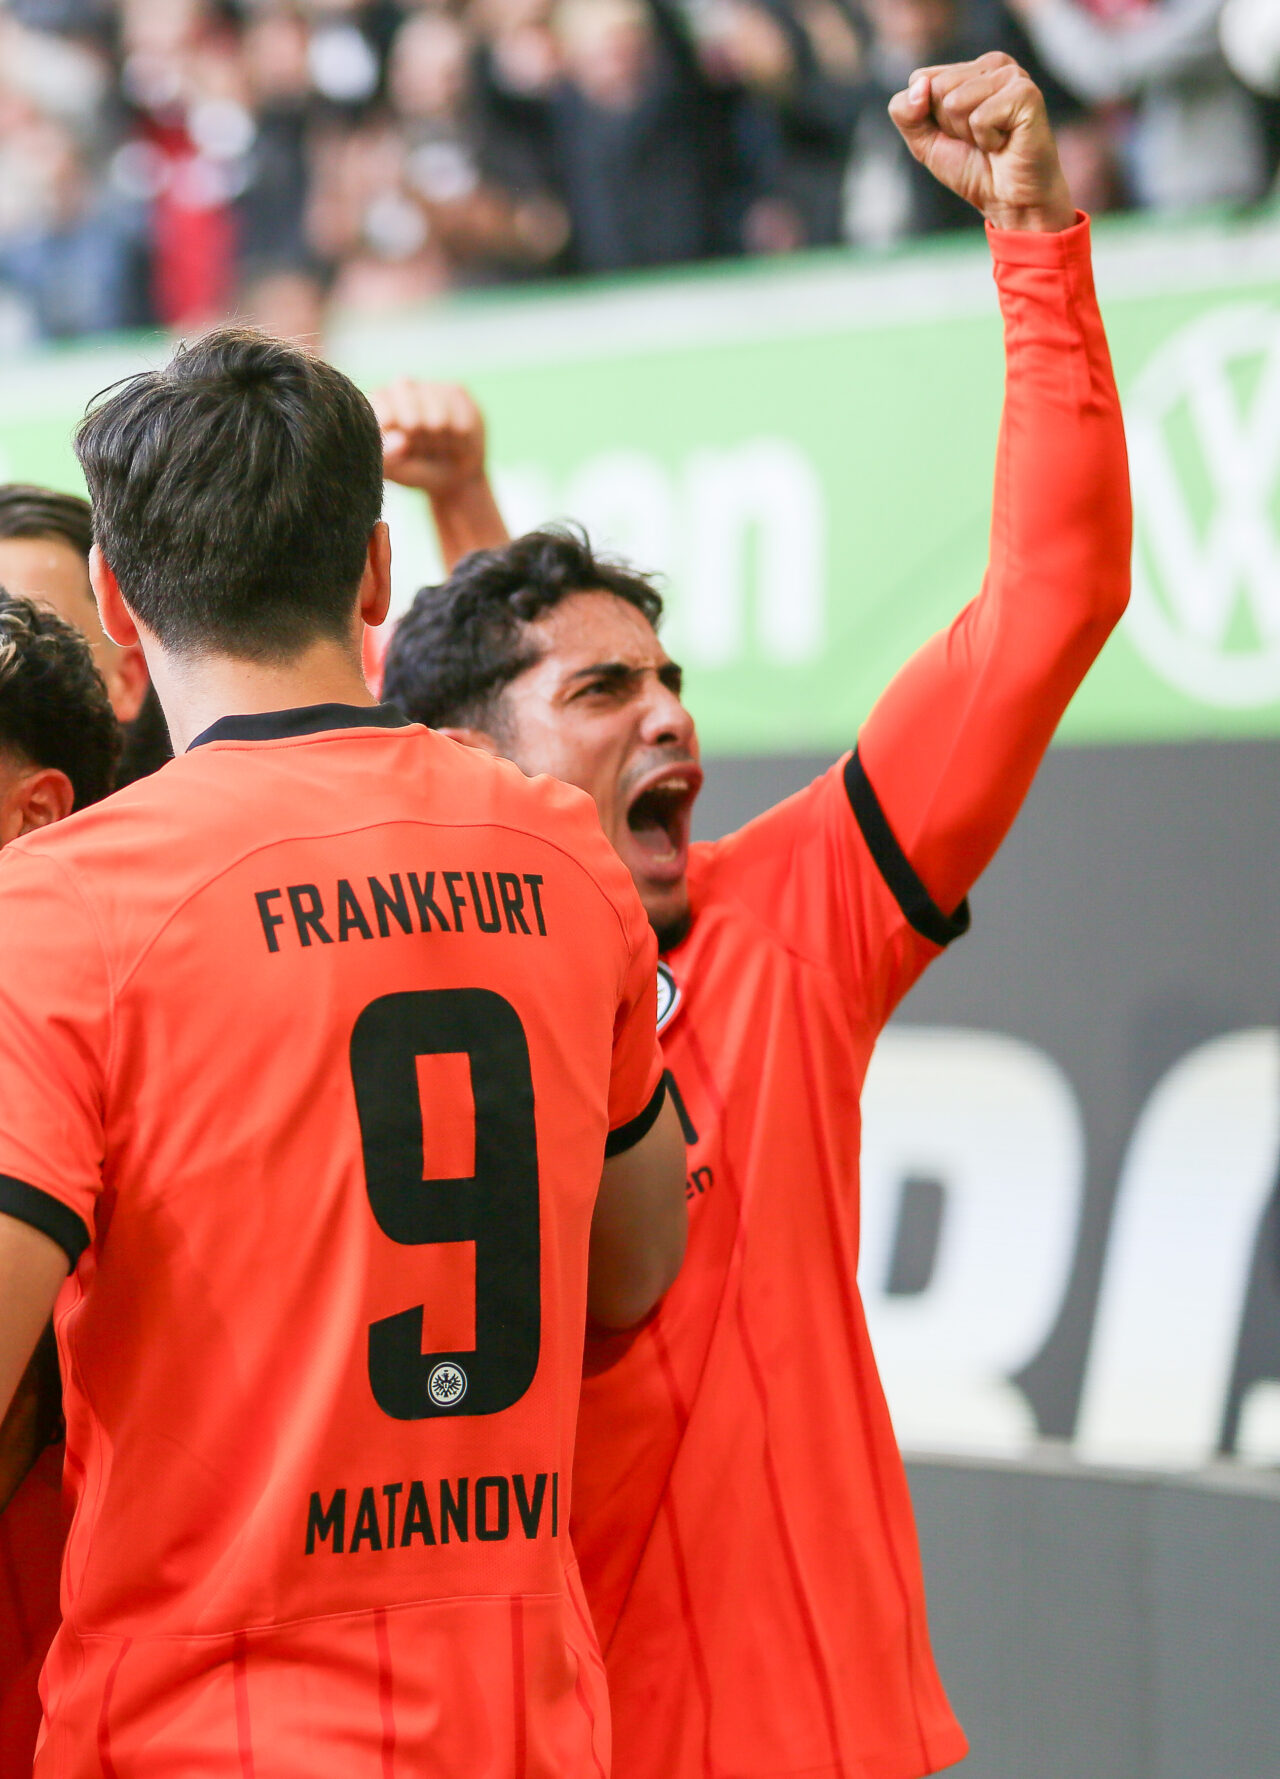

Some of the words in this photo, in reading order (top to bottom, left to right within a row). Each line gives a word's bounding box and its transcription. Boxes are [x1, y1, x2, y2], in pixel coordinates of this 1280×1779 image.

[255, 871, 549, 953] FRANKFURT
[349, 987, 542, 1422] 9
[305, 1471, 559, 1556] MATANOVI
